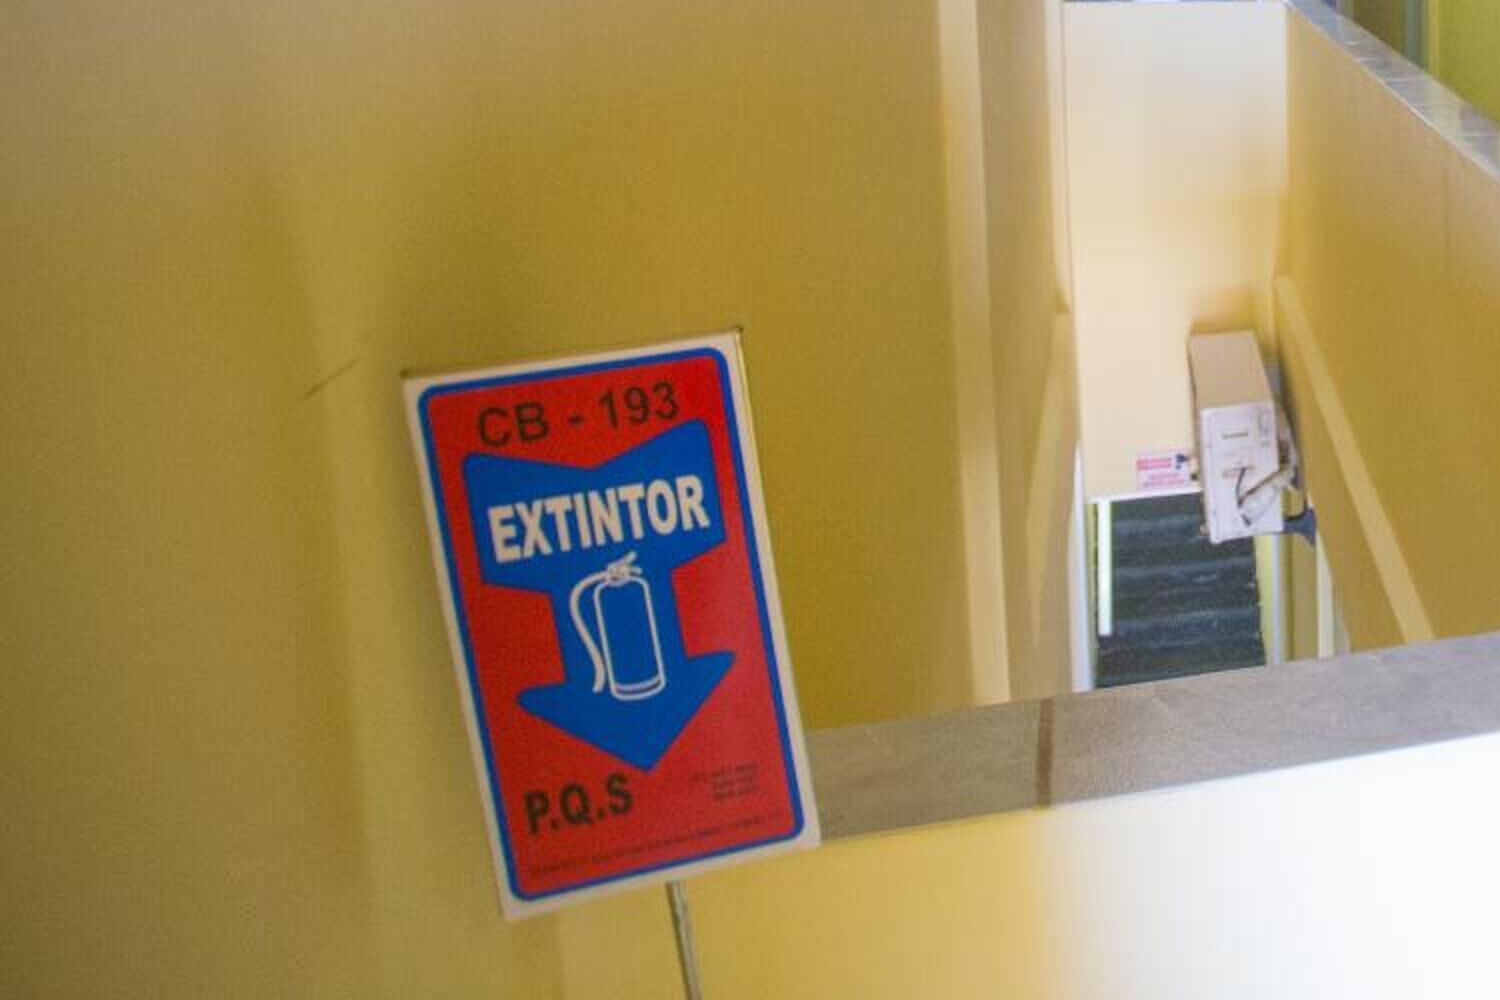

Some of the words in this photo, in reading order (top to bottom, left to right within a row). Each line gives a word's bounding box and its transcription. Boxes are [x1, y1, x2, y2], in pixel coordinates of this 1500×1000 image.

[479, 401, 549, 447] CB
[601, 381, 679, 429] 193
[487, 475, 710, 563] EXTINTOR
[523, 772, 634, 835] P.Q.S
